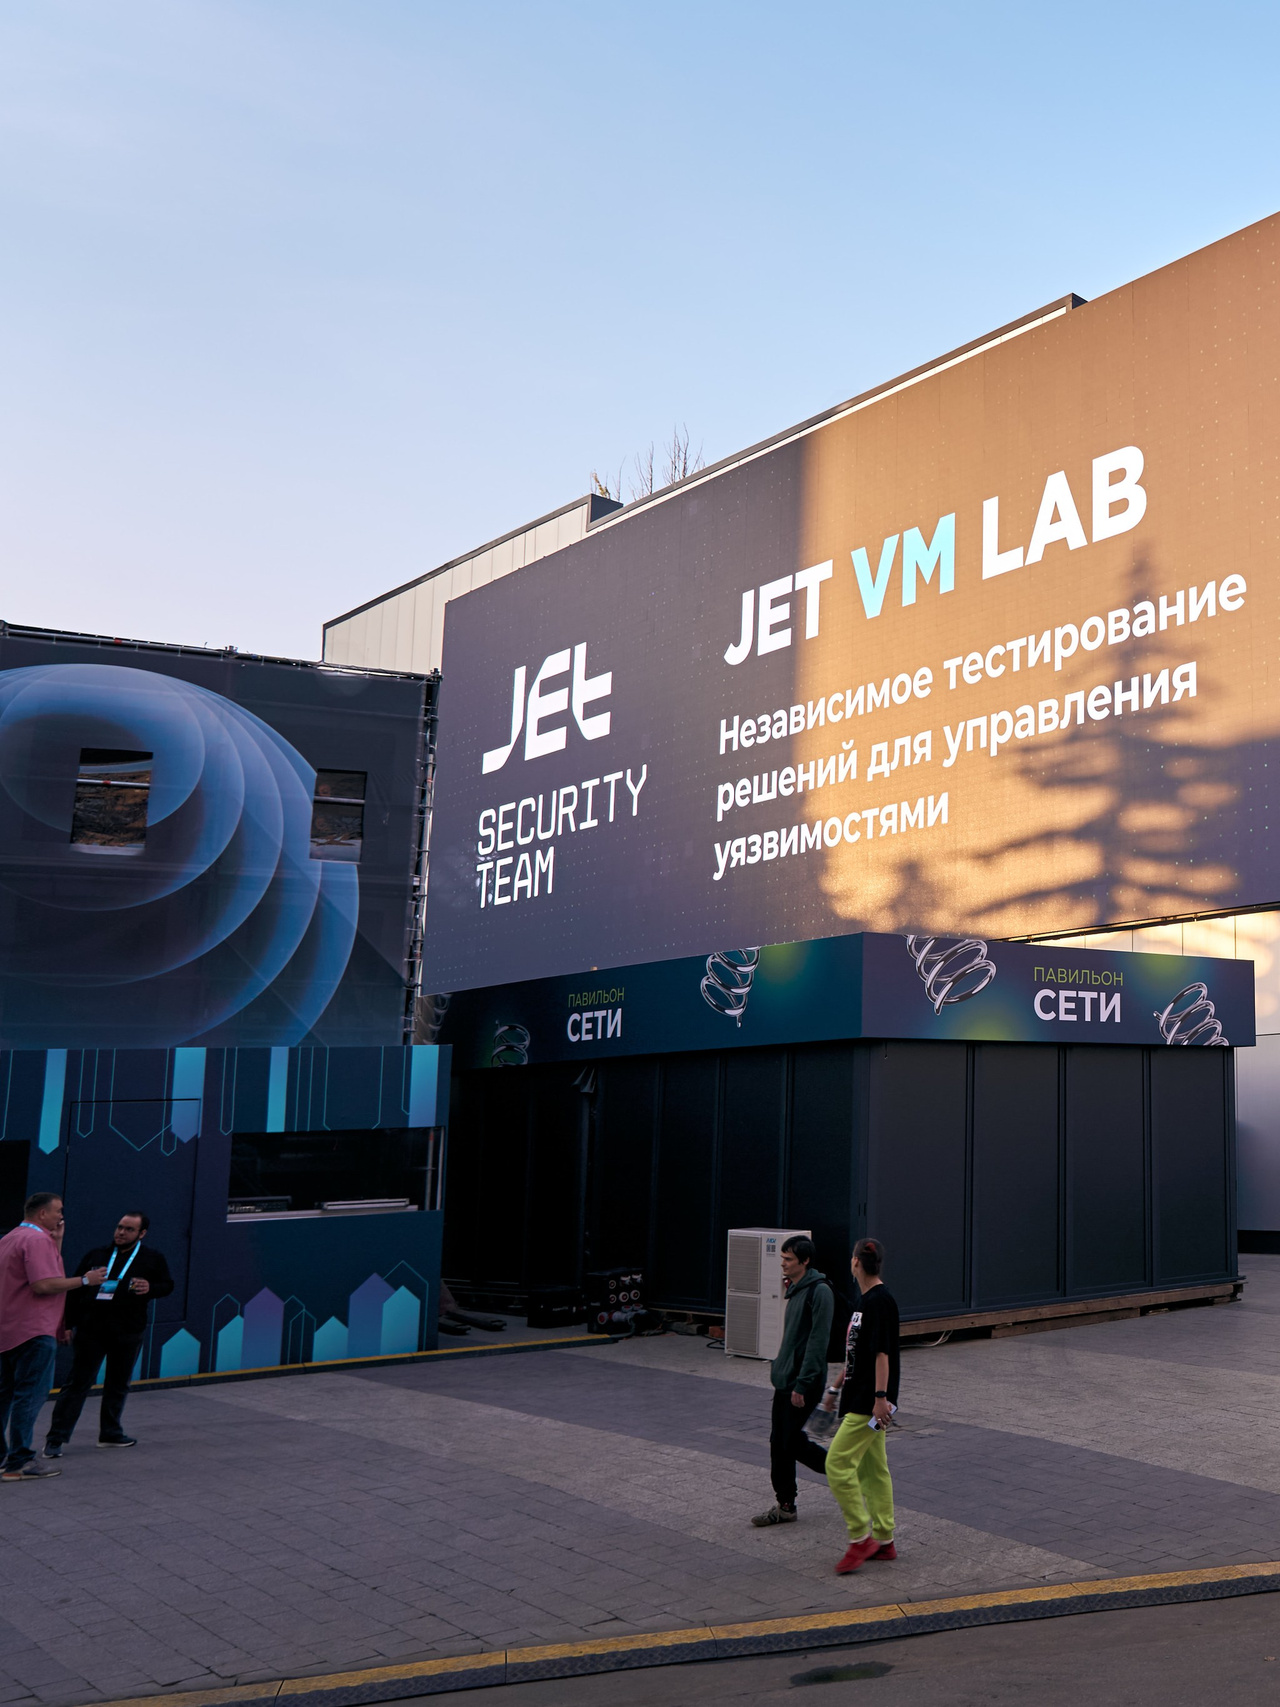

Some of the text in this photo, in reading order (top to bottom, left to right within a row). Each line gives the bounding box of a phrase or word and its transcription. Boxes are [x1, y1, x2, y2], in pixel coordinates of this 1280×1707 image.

[724, 445, 1148, 666] JET VM LAB
[718, 573, 1248, 755] Независимое тестирование
[716, 661, 1198, 822] решений для управления
[477, 763, 648, 856] SECURITY
[712, 792, 949, 881] уязвимостями
[476, 845, 555, 909] TEAM
[567, 986, 625, 1008] ПАВИЛЬОН
[1033, 966, 1124, 986] ПАВИЛЬОН
[1033, 988, 1122, 1023] СЕТИ
[566, 1007, 623, 1043] СЕТИ
